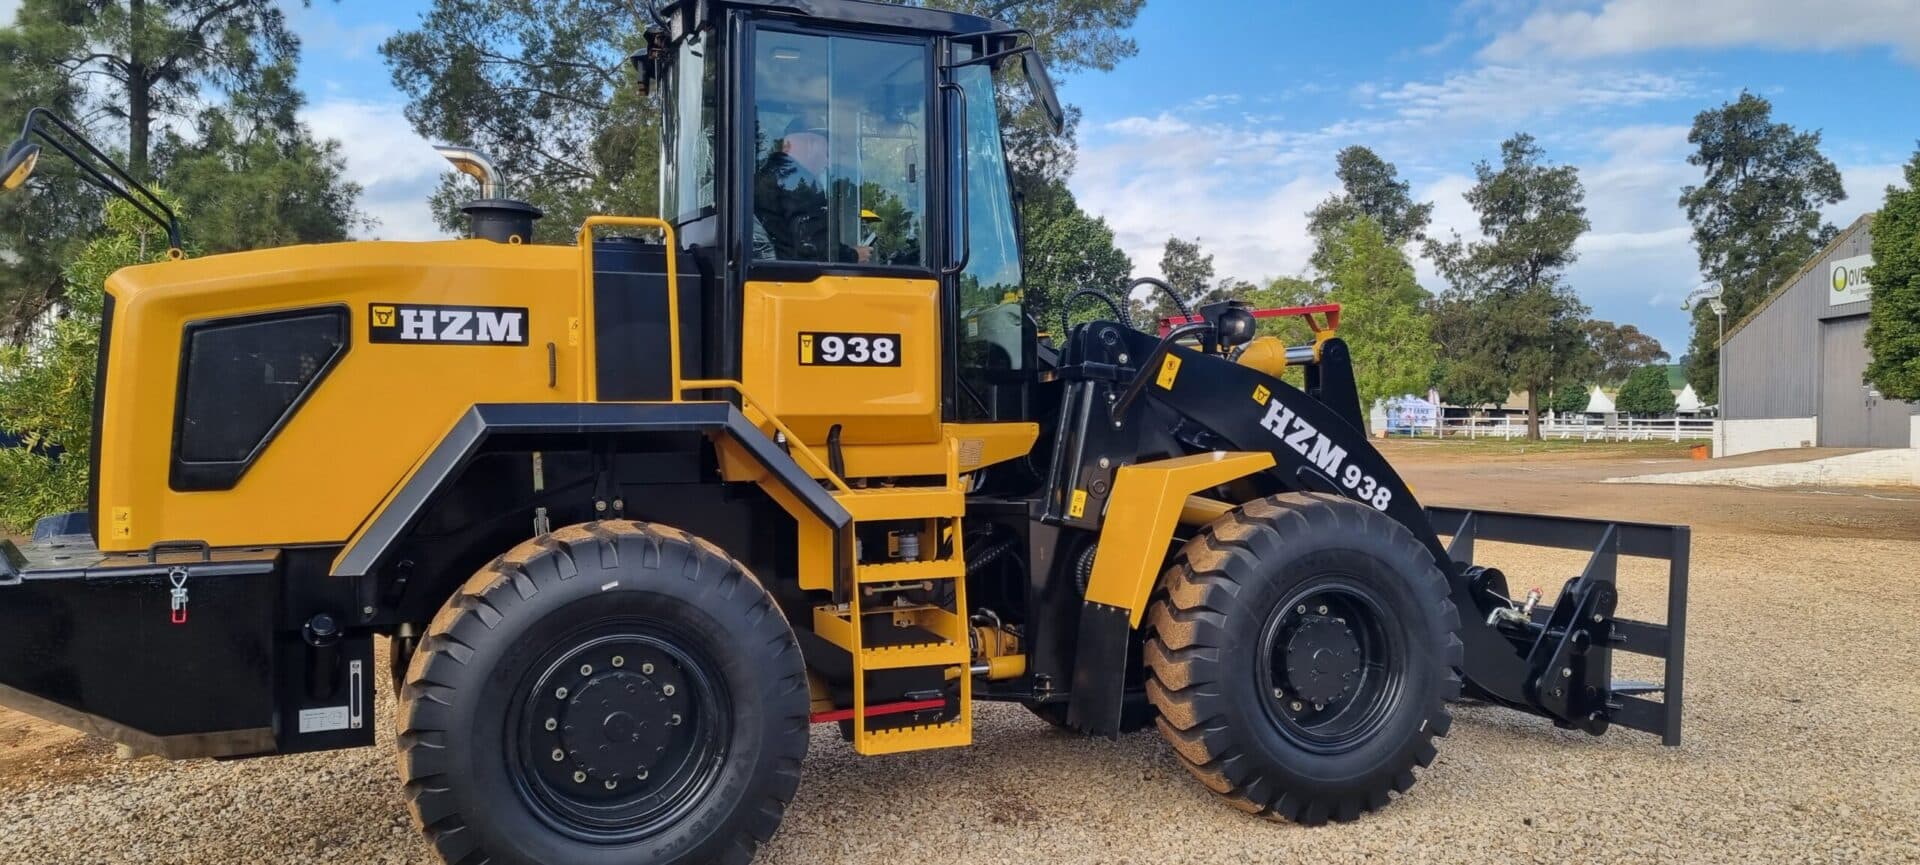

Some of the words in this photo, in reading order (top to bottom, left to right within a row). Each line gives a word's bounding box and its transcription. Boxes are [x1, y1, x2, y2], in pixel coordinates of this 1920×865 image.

[400, 309, 522, 342] HZM
[821, 336, 895, 363] 938
[1260, 398, 1348, 478] HZM
[1342, 464, 1392, 511] 938
